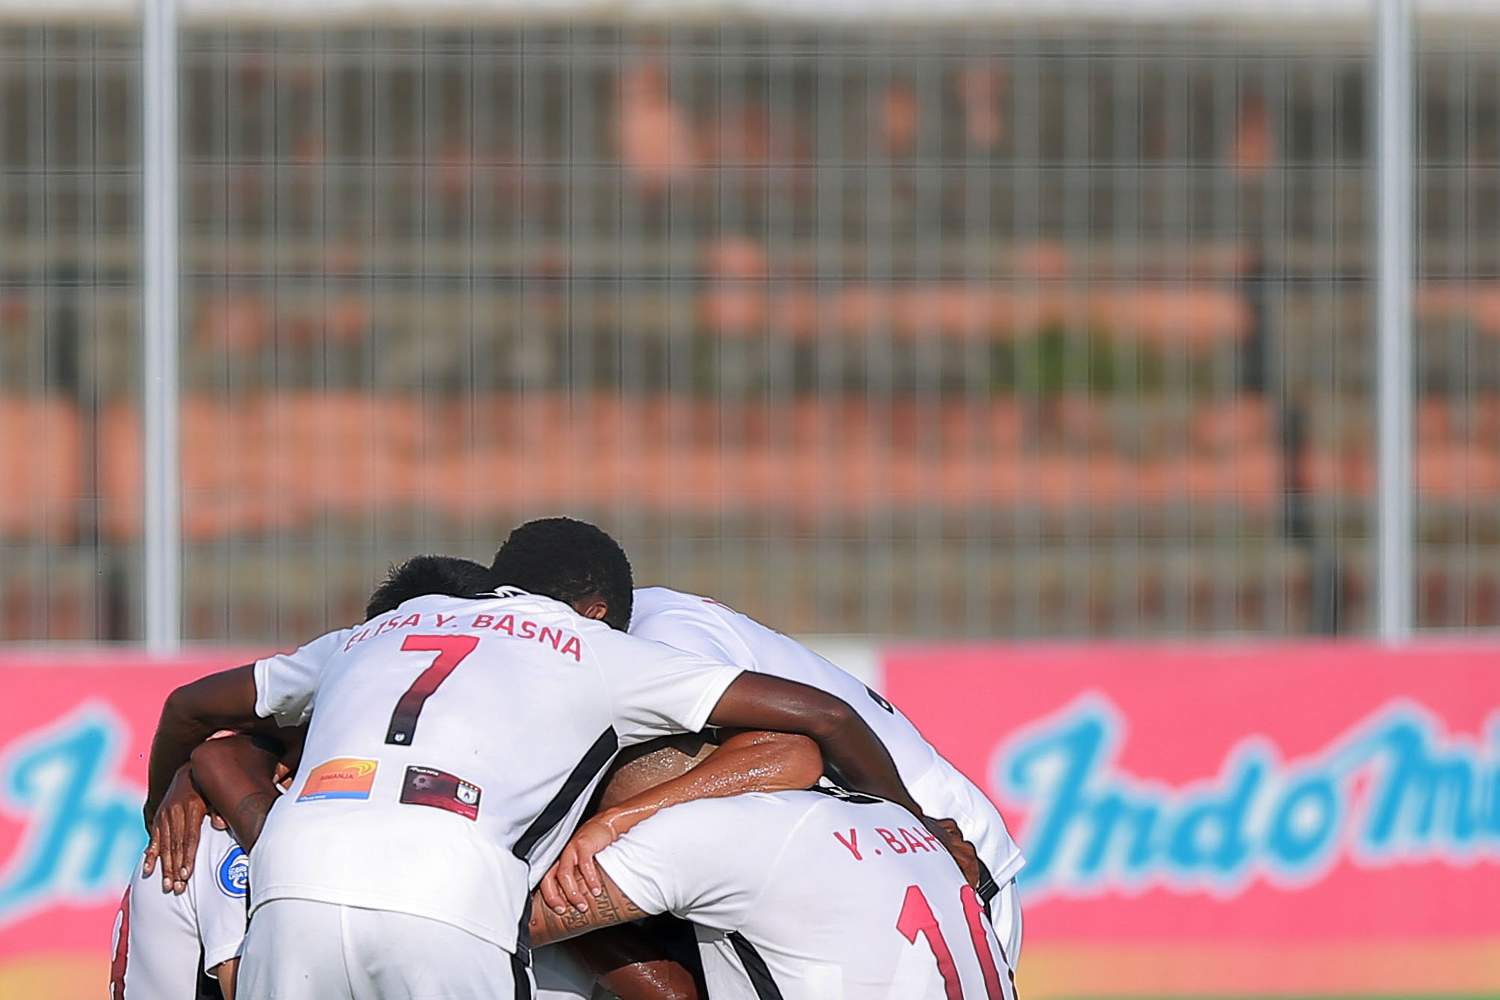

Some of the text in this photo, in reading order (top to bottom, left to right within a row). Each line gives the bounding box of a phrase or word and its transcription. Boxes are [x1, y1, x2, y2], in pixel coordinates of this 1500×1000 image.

[343, 613, 421, 653] ELISA
[471, 614, 581, 662] BASNA
[384, 634, 480, 746] 7
